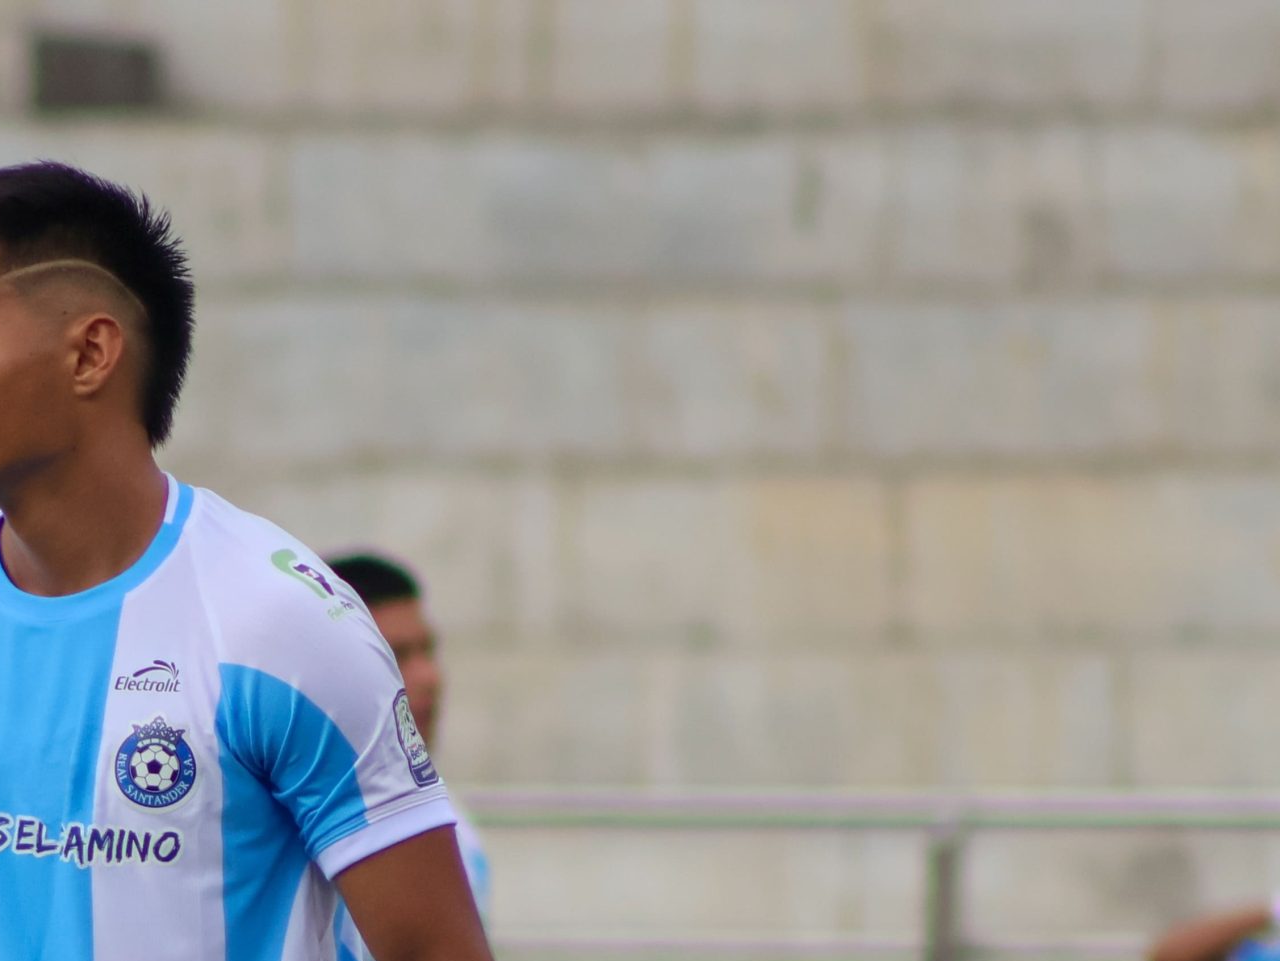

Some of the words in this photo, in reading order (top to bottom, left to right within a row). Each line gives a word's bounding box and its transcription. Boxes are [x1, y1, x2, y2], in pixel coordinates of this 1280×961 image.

[114, 675, 182, 692] Electrolit
[117, 753, 128, 783] REAL
[125, 780, 190, 805] SANTANDER
